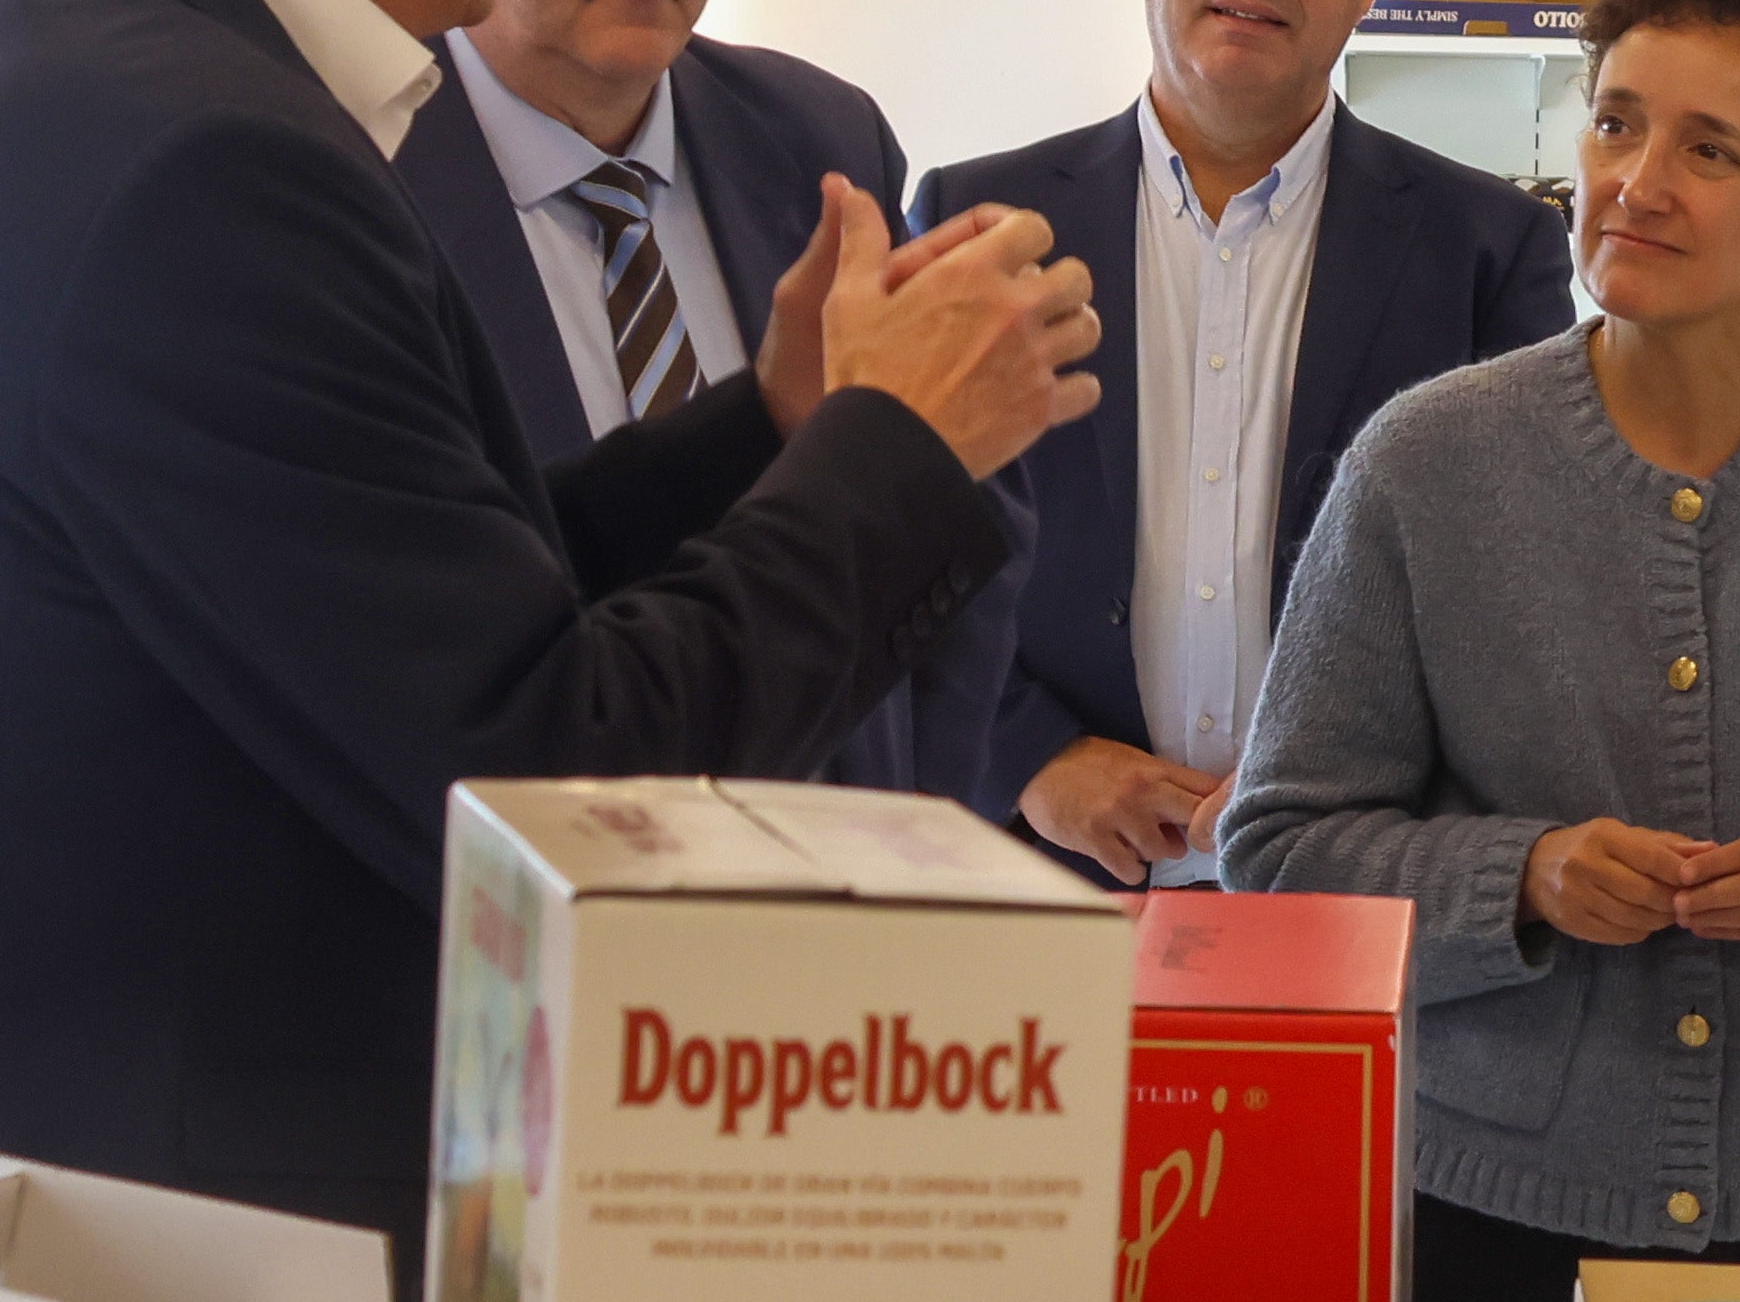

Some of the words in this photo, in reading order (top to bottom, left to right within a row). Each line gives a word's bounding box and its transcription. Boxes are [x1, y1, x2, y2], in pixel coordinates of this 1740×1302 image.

[1363, 7, 1388, 20] BES
[1390, 8, 1413, 21] THE
[1414, 9, 1459, 22] SIMPLY
[617, 1007, 1068, 1138] Doppelbock
